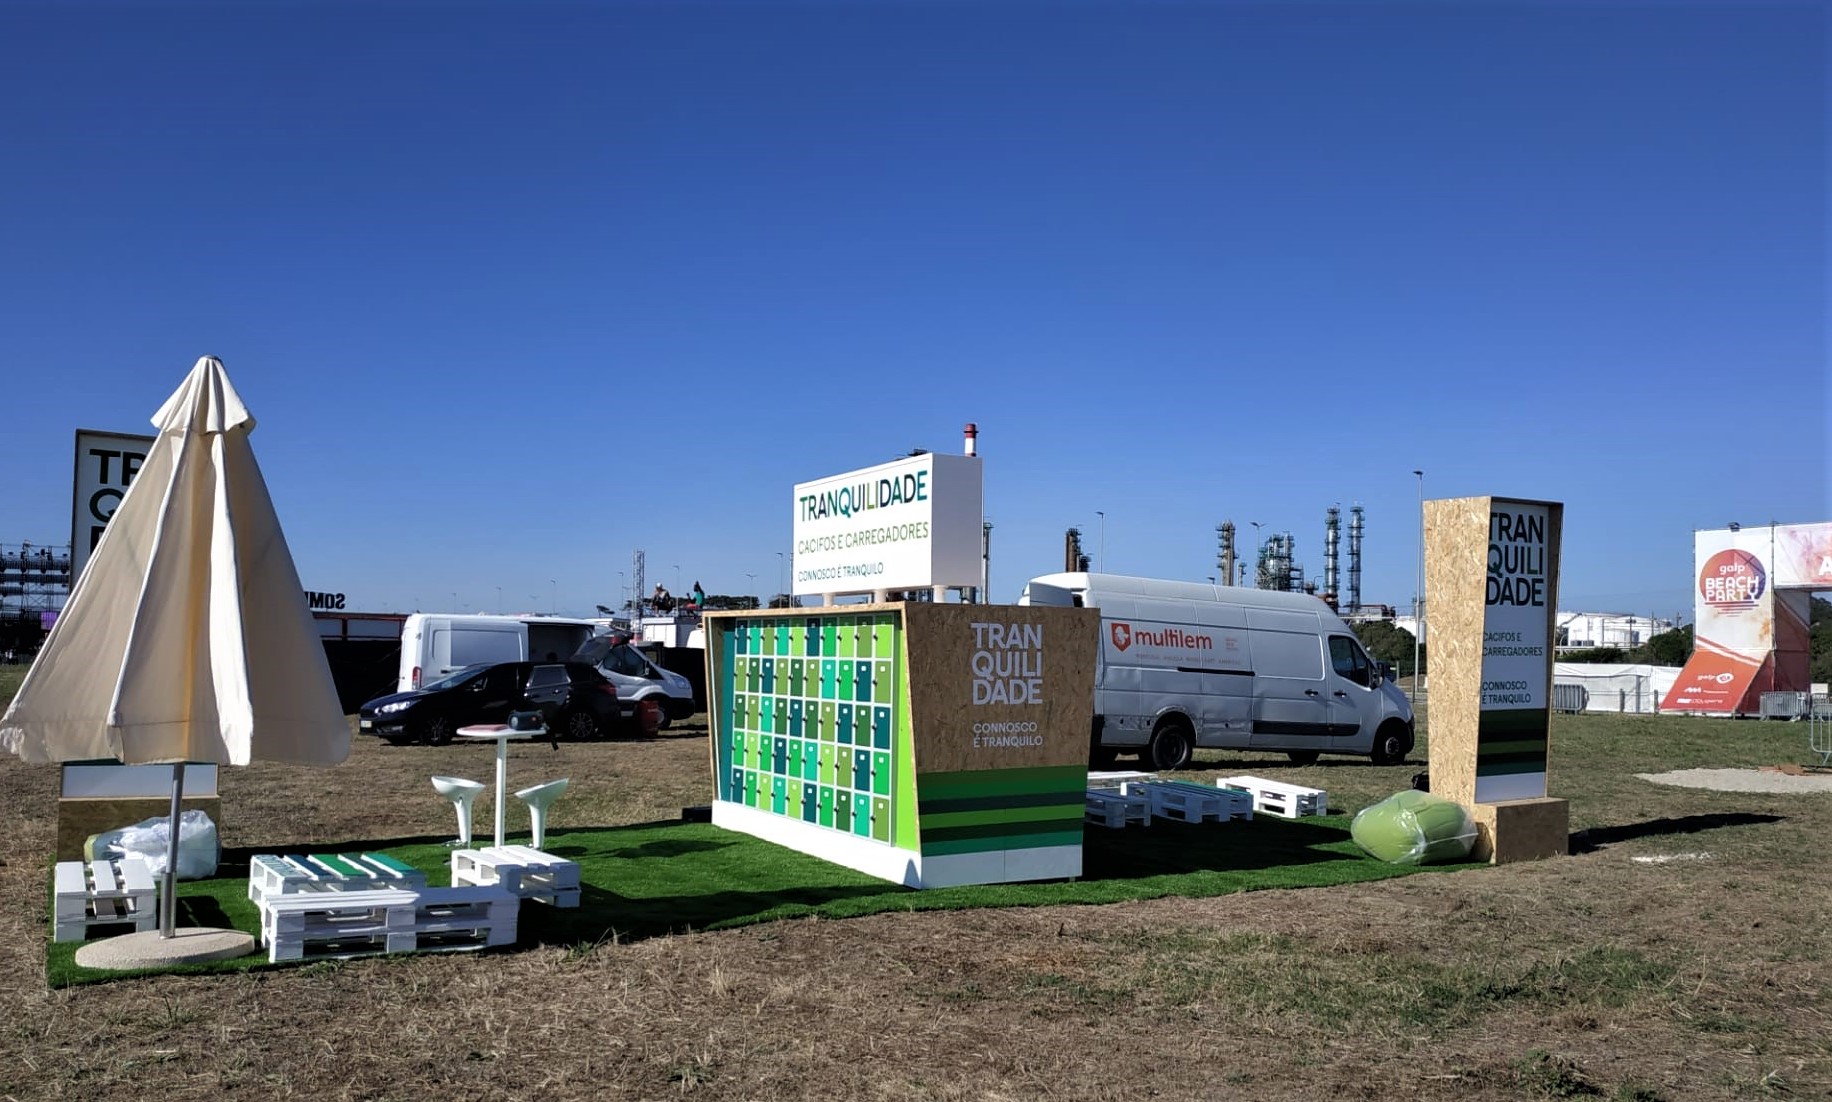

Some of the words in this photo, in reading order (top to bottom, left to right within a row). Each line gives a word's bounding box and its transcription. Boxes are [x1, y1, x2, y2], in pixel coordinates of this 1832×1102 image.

[799, 470, 928, 522] TRANQUILIDADE
[798, 535, 836, 555] CACIFOS
[838, 535, 844, 549] E
[845, 521, 929, 548] CARREGADORES
[1489, 512, 1544, 544] TRAN
[1487, 544, 1543, 579] QUILI
[1719, 563, 1746, 575] galp
[798, 567, 836, 582] CONNOSCO
[837, 564, 842, 578] É
[843, 562, 884, 578] TRANQUILO
[1485, 576, 1544, 607] DADE
[1705, 576, 1760, 589] BEACH
[1705, 588, 1759, 601] PARTY
[970, 623, 1043, 649] TRAN
[1135, 629, 1213, 650] multilem
[1483, 632, 1516, 641] CACIFOS
[1516, 632, 1522, 641] E
[1482, 646, 1543, 656] CARREGADORES
[971, 651, 1042, 681] QUILI
[972, 679, 1043, 705] DADE
[1482, 681, 1528, 691] CONNOSCO
[1482, 692, 1487, 704] É
[1488, 693, 1532, 705] TRANQUILO
[973, 722, 1038, 733] CONNOSCO
[973, 731, 981, 748] É
[983, 735, 1043, 748] TRANQUILO
